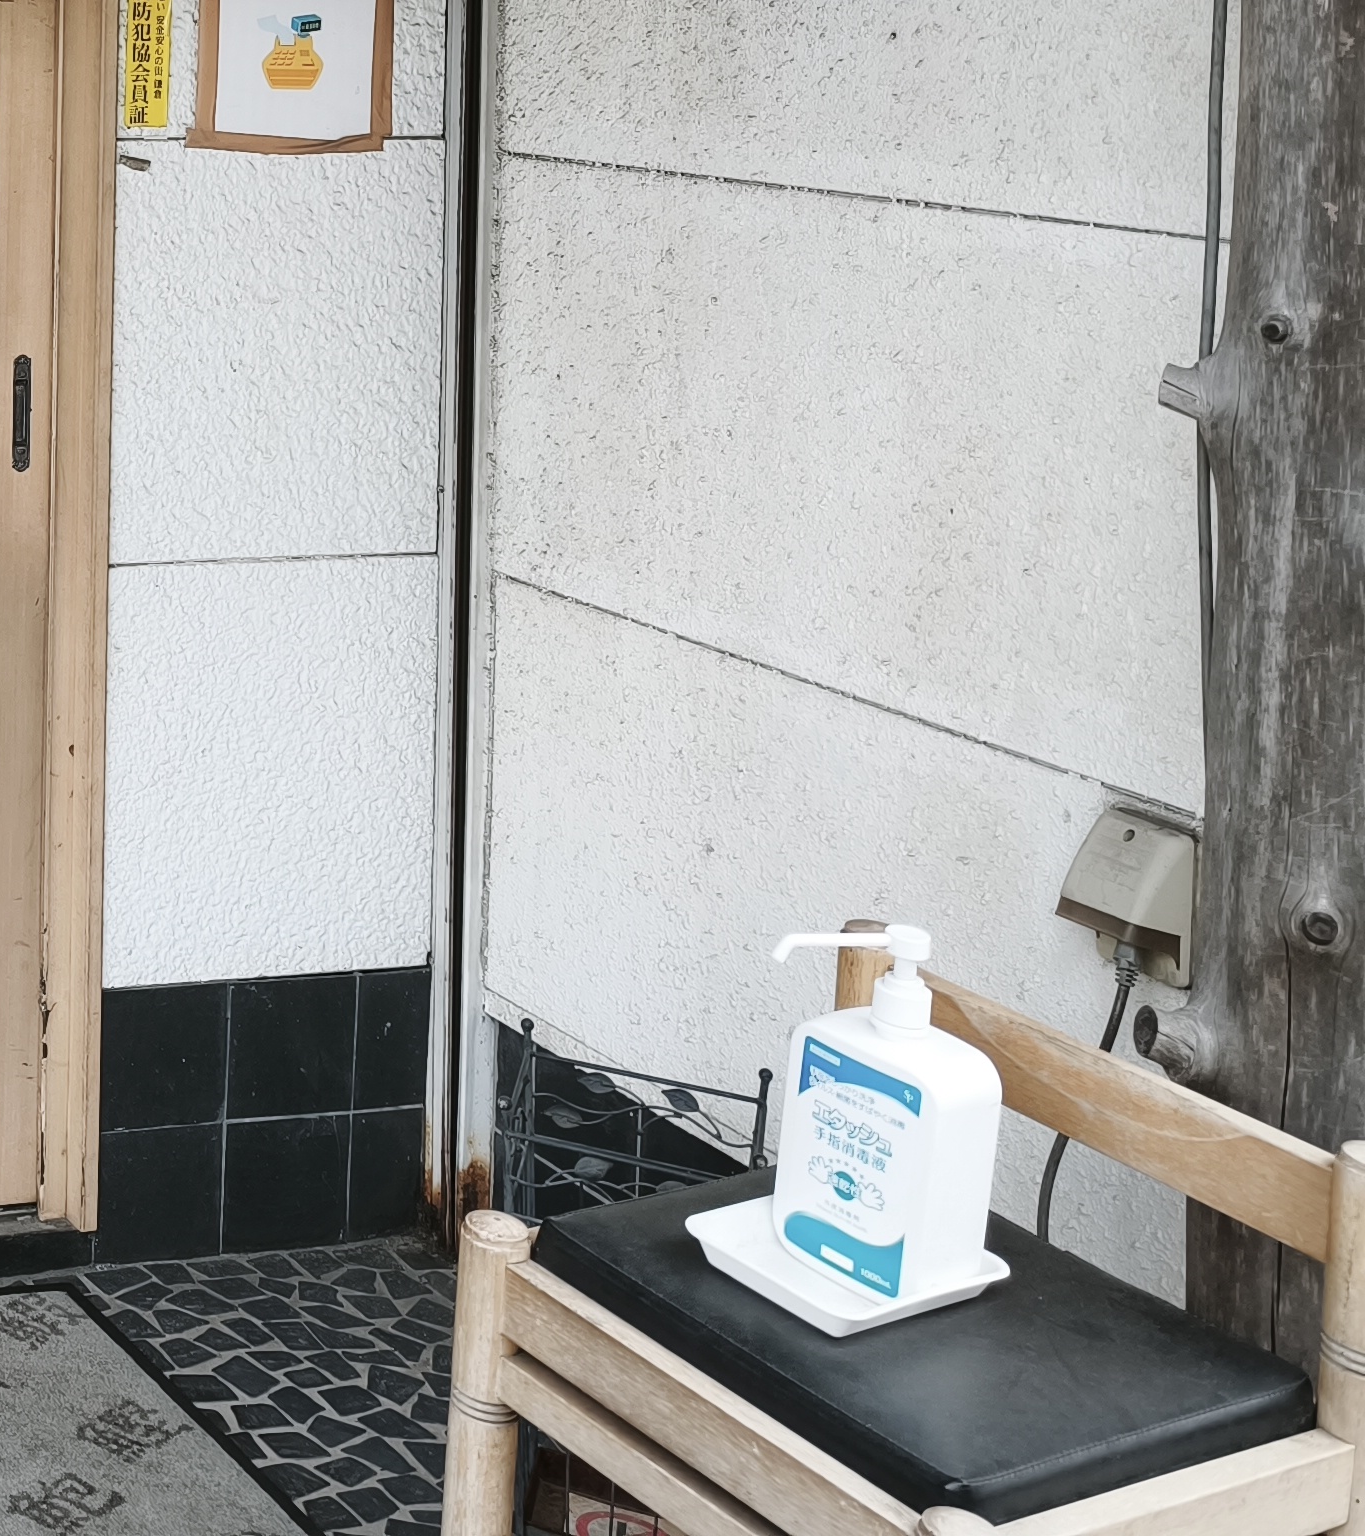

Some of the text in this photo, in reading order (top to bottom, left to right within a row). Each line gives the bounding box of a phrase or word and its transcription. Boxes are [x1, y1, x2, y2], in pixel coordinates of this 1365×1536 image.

[812, 1099, 893, 1157] エタッシュ
[813, 1125, 886, 1173] 手指消毒液
